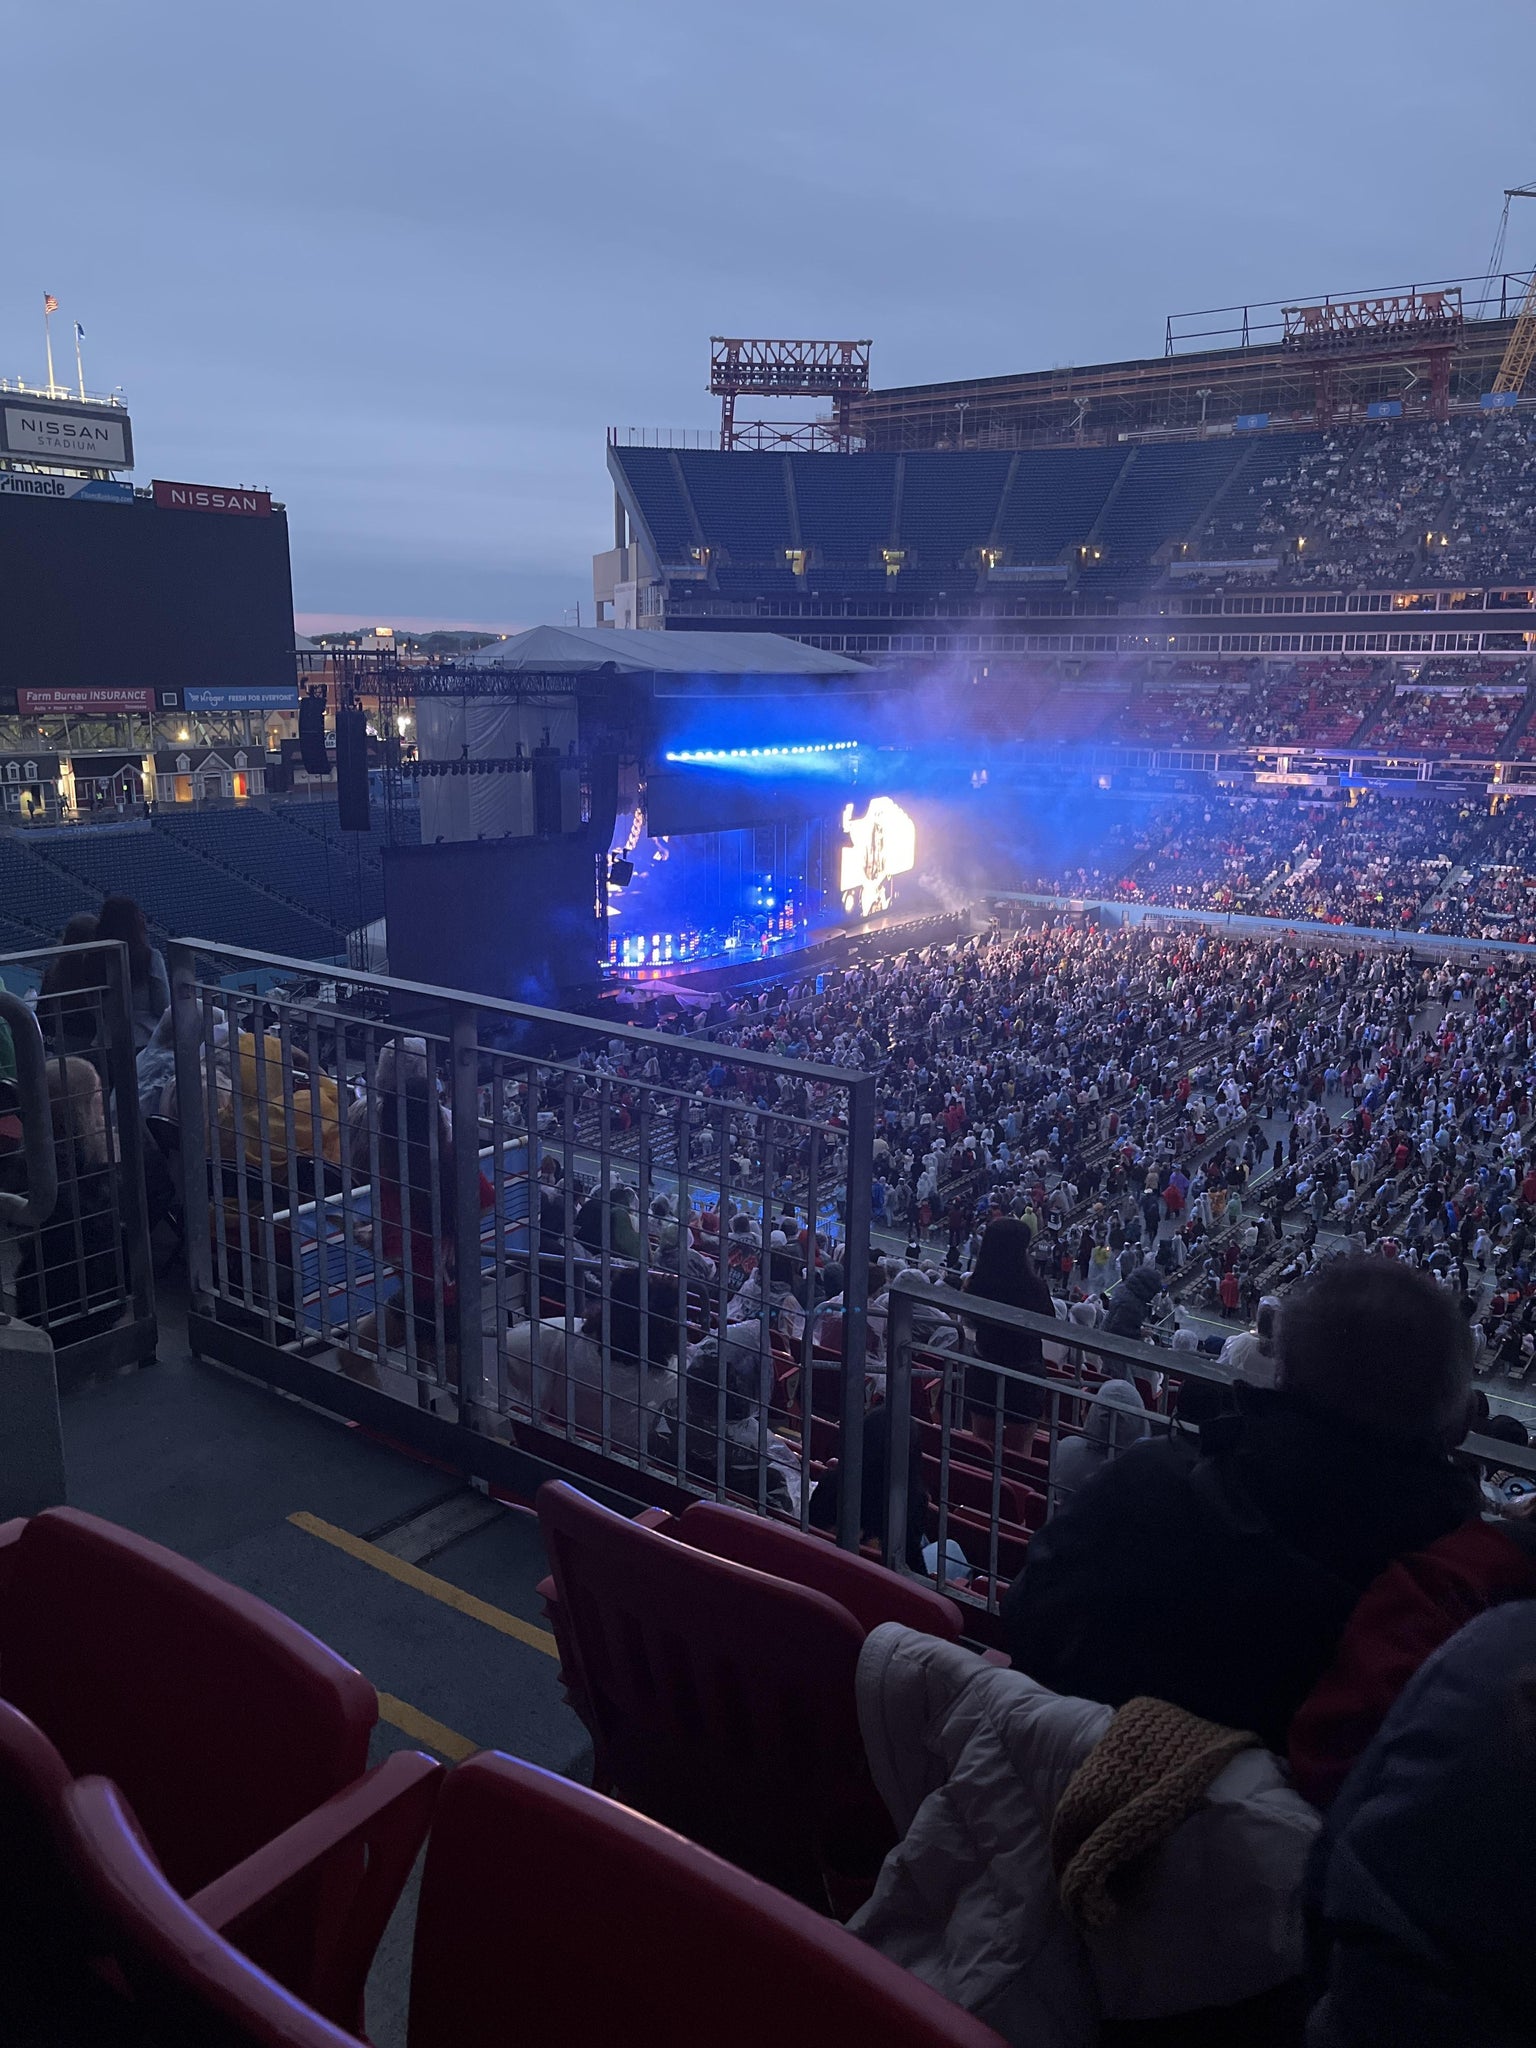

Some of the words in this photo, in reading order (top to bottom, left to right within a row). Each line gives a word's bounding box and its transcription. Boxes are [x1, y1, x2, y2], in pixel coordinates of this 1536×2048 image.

[21, 418, 109, 441] NISSAN
[37, 436, 97, 452] STADIUM
[0, 473, 66, 497] Pinnacle
[170, 489, 257, 511] NISSAN
[26, 691, 51, 701] Farm
[54, 691, 87, 701] Bureau
[90, 690, 147, 701] INSURANCE
[200, 690, 225, 707] Kroger
[228, 694, 247, 702] FRESH
[248, 694, 261, 702] FOR
